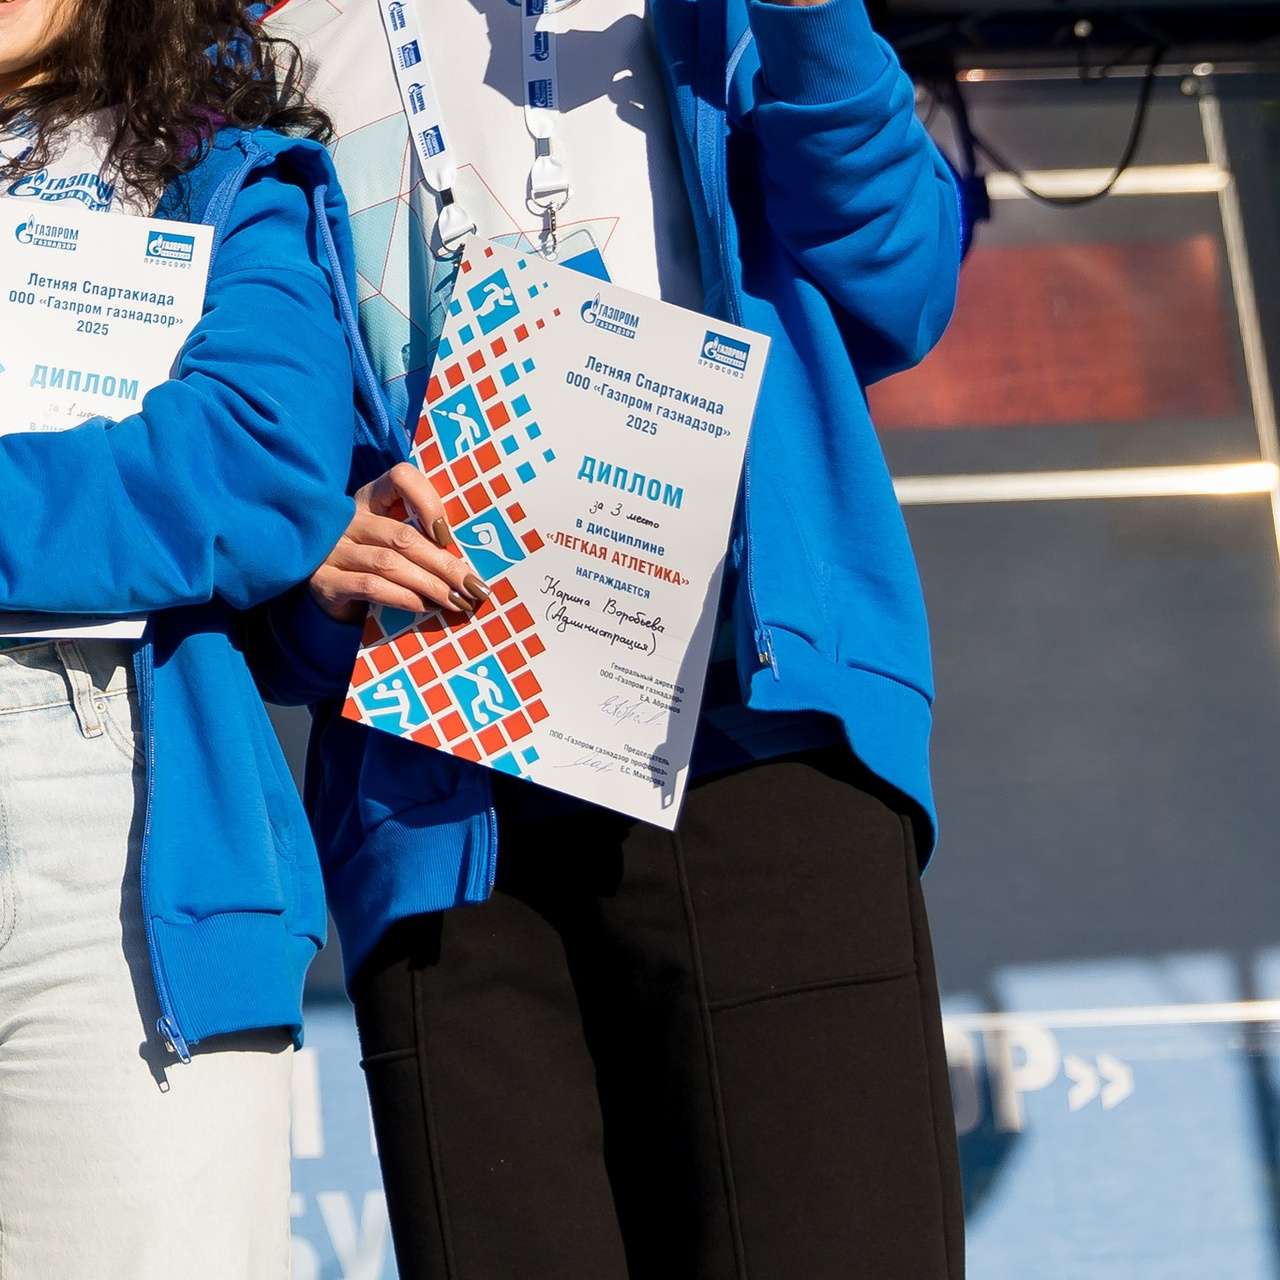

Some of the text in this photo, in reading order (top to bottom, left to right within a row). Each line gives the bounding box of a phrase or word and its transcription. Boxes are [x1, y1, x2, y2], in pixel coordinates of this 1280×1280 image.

[33, 238, 77, 251] ГАЗНАДЗОР
[34, 223, 80, 241] ГАЗПРОМ
[27, 272, 175, 306] Летняя Спартакиада
[8, 290, 184, 328] ООО «Газпром газнадзор»
[597, 303, 640, 328] ГАЗПРОМ
[76, 320, 110, 336] 2025
[595, 318, 636, 340] ГАЗНАДЗОР
[717, 343, 747, 361] ГАЗПРОМ
[29, 364, 139, 401] ДИПЛОМ
[697, 358, 745, 380] ПРОФСОЮЗ
[585, 355, 725, 416] Летняя Спартакиада
[565, 370, 731, 439] ООО «Газпром газнадзор»
[625, 414, 659, 437] 2025
[577, 455, 684, 510] ДИПЛОМ
[589, 500, 660, 529] за 3 место
[586, 522, 666, 557] дисциплине
[546, 530, 690, 586] «ЛЕГКАЯ АТЛЕТИКА»
[575, 566, 651, 600] НАГРАЖДАЕТСЯ
[539, 575, 666, 634] Карина Воробьева
[545, 600, 657, 657] (Администрация)
[599, 668, 614, 681] ООО
[614, 675, 645, 691] «Газпром
[610, 661, 685, 694] Генеральный директор
[651, 697, 681, 714] Абрамов
[548, 729, 563, 741] ППО
[595, 745, 630, 764] газнадзор
[623, 743, 670, 766] Председатель
[632, 769, 666, 787] Макарова
